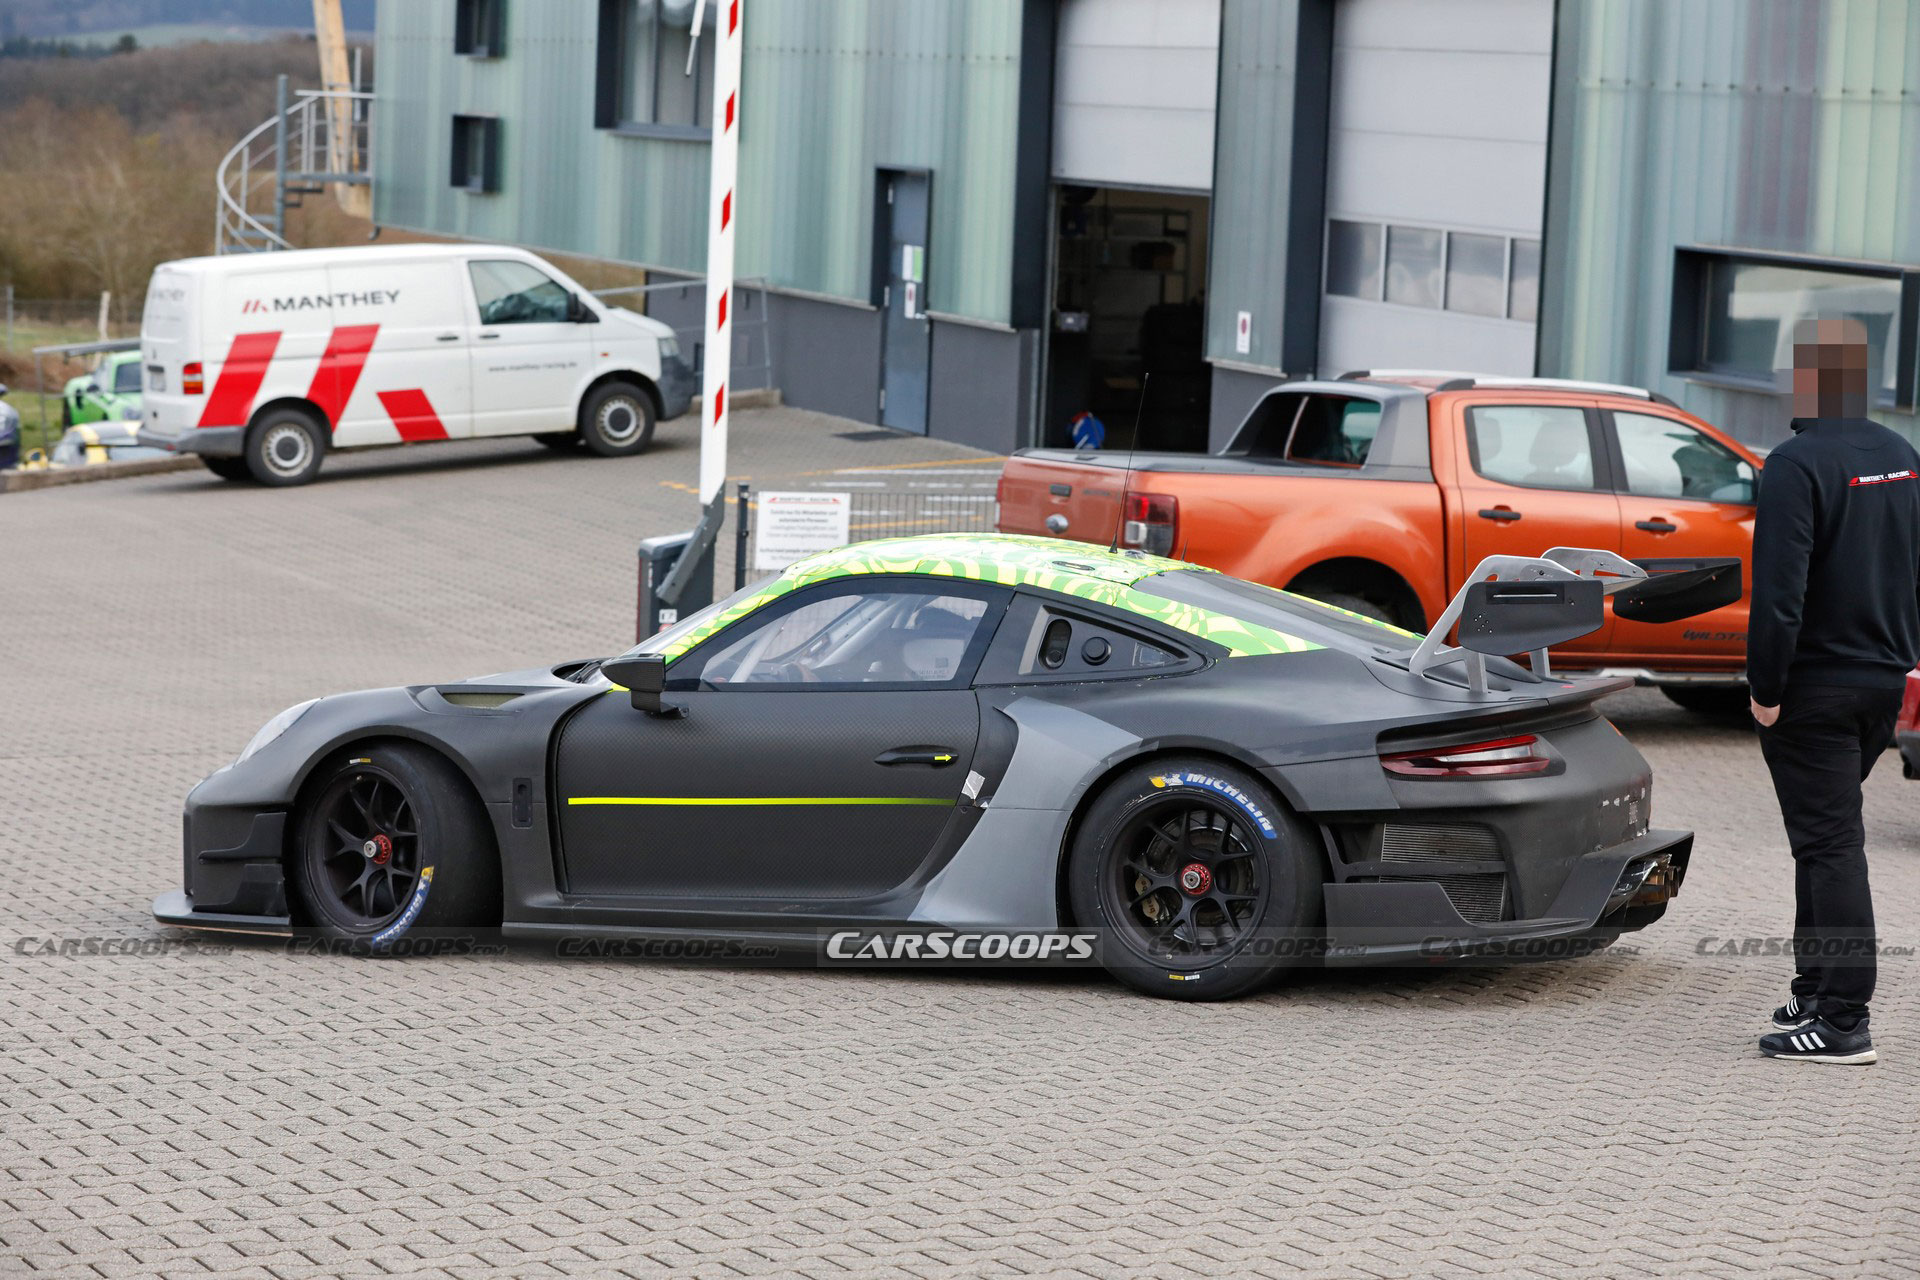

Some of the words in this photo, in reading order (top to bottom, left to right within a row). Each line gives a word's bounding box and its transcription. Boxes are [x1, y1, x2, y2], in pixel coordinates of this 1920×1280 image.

[273, 289, 400, 312] MANTHEY
[1858, 474, 1885, 483] MANTHEY
[1887, 470, 1910, 480] RACING
[1185, 773, 1274, 831] MICHELIN
